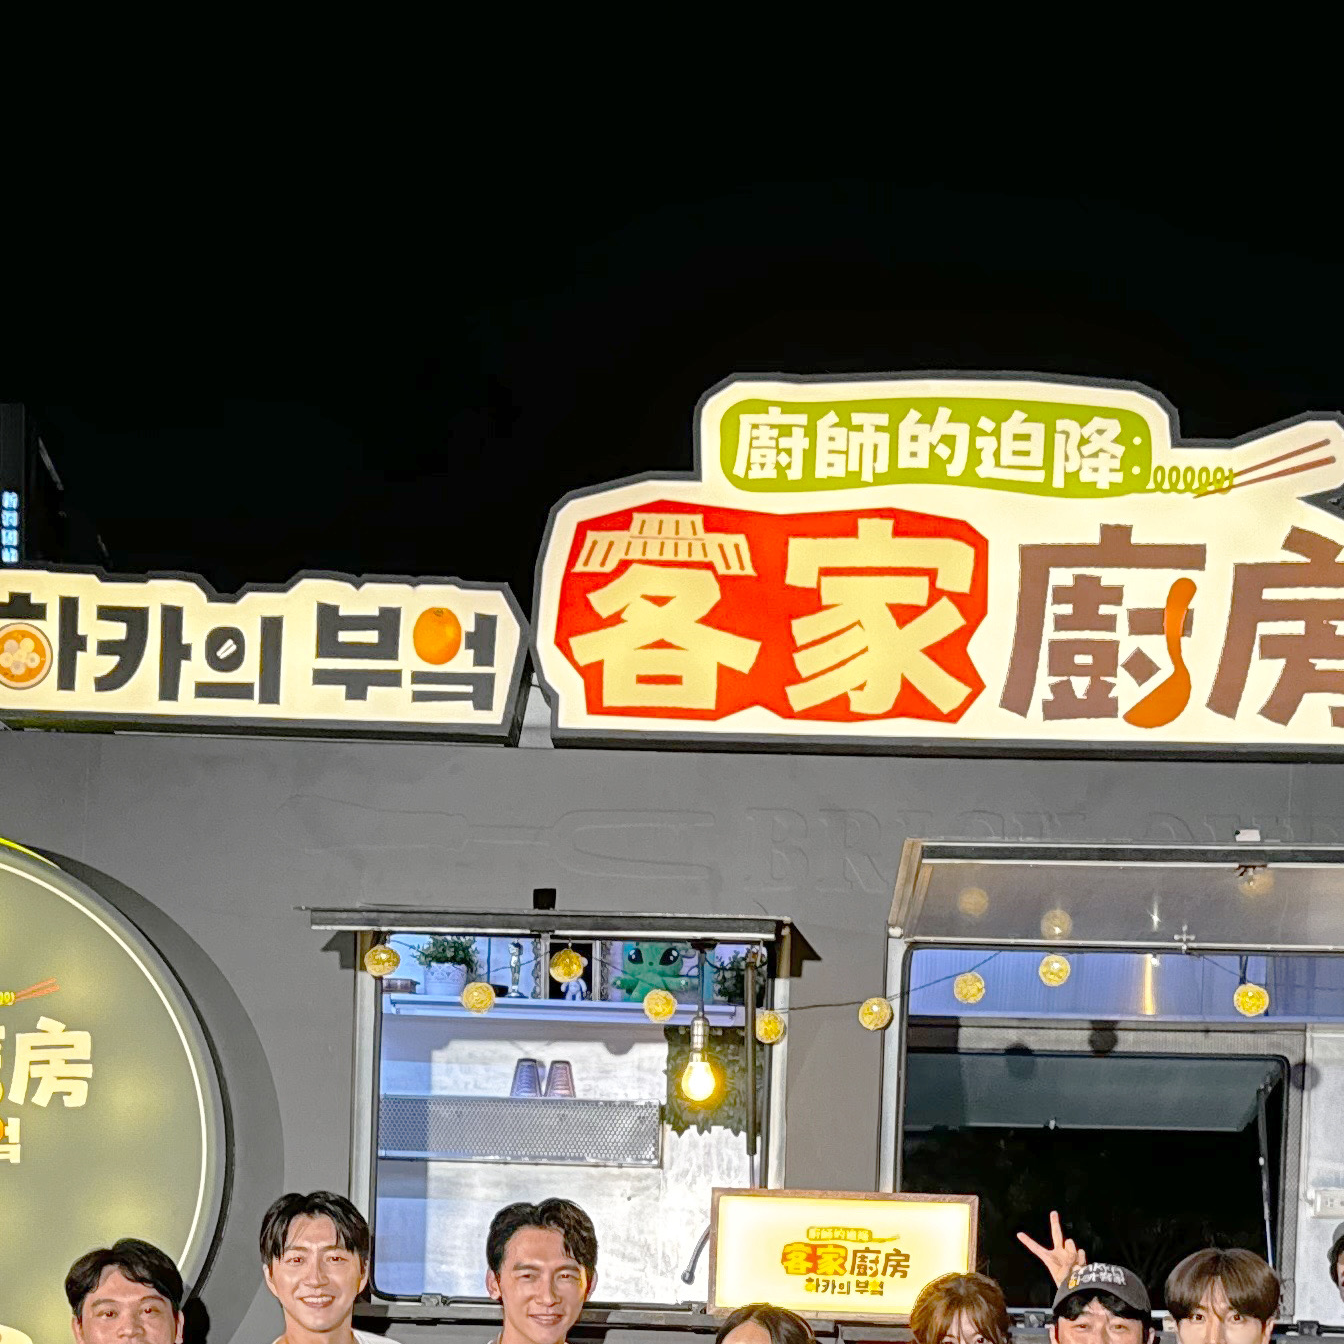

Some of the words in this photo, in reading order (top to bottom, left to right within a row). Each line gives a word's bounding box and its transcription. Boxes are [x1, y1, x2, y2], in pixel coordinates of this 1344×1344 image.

[312, 602, 497, 711] 부엌
[782, 1242, 910, 1278] 客家廚房
[805, 1277, 851, 1295] 하카의
